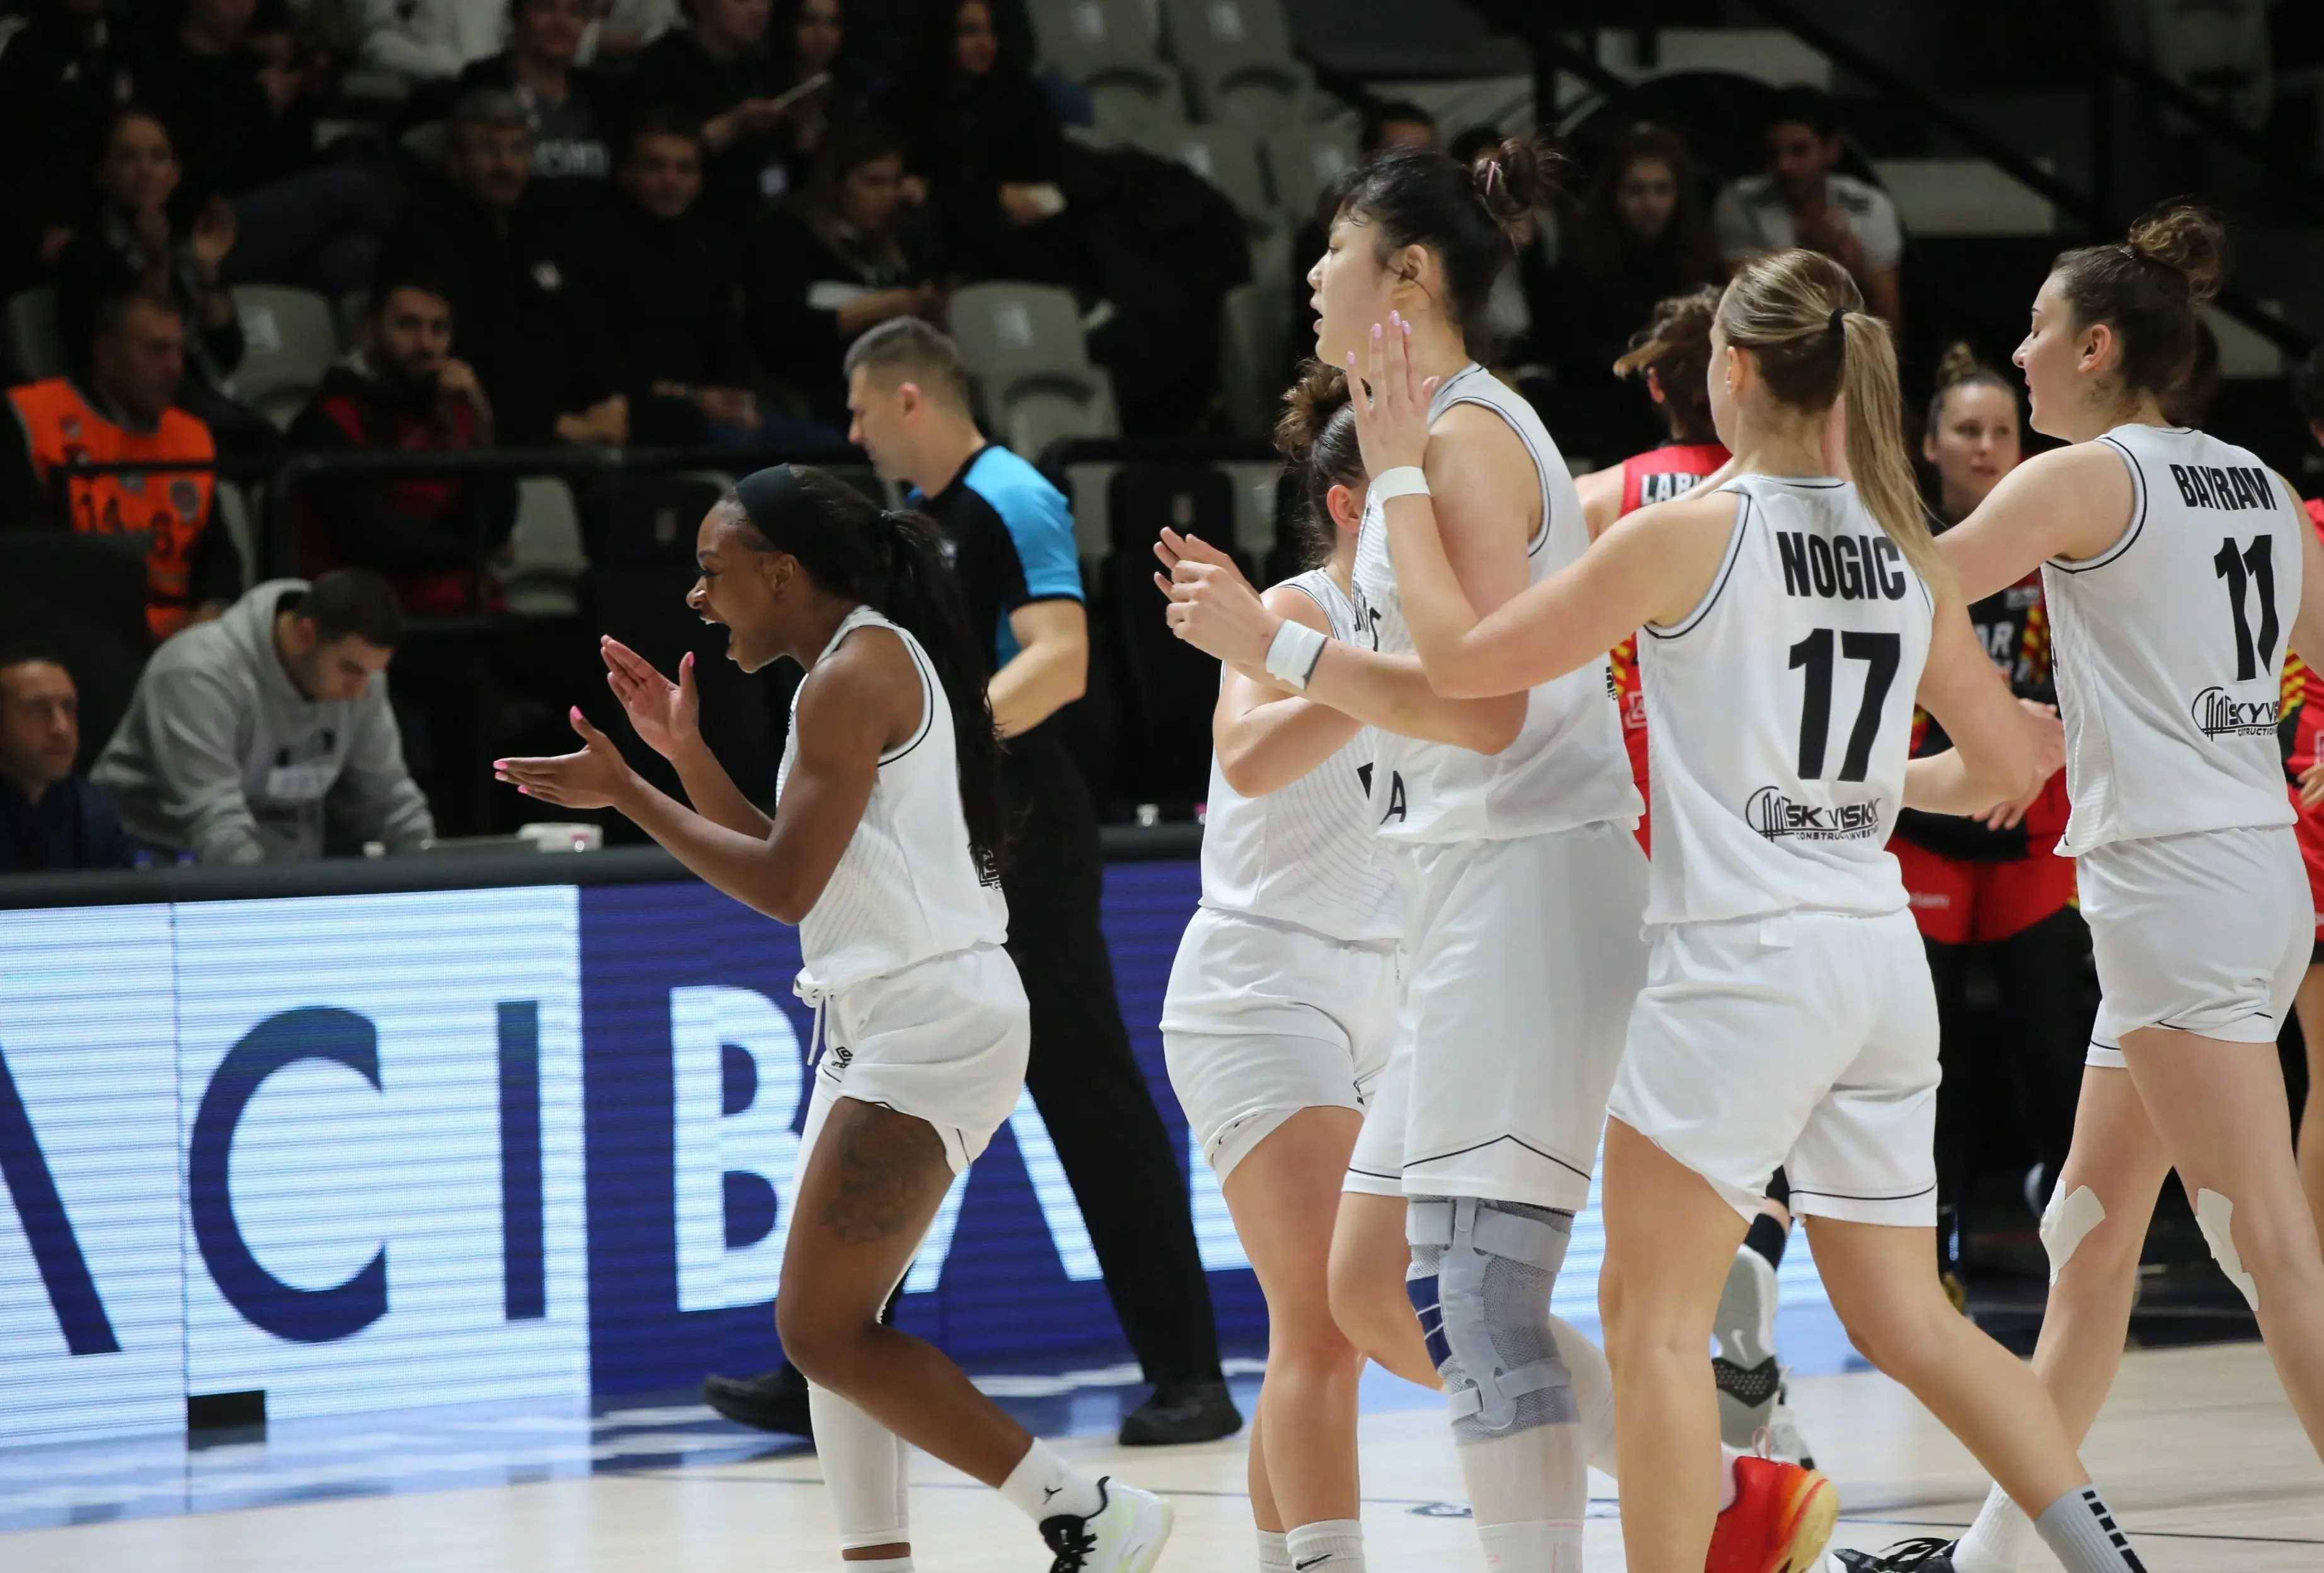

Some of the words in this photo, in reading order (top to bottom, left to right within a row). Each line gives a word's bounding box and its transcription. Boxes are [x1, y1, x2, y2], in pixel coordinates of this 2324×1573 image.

[2169, 464, 2277, 510] BAYRAM
[1777, 531, 1906, 600] NOGIC
[2214, 534, 2279, 682] 11
[1789, 628, 1901, 782] 17
